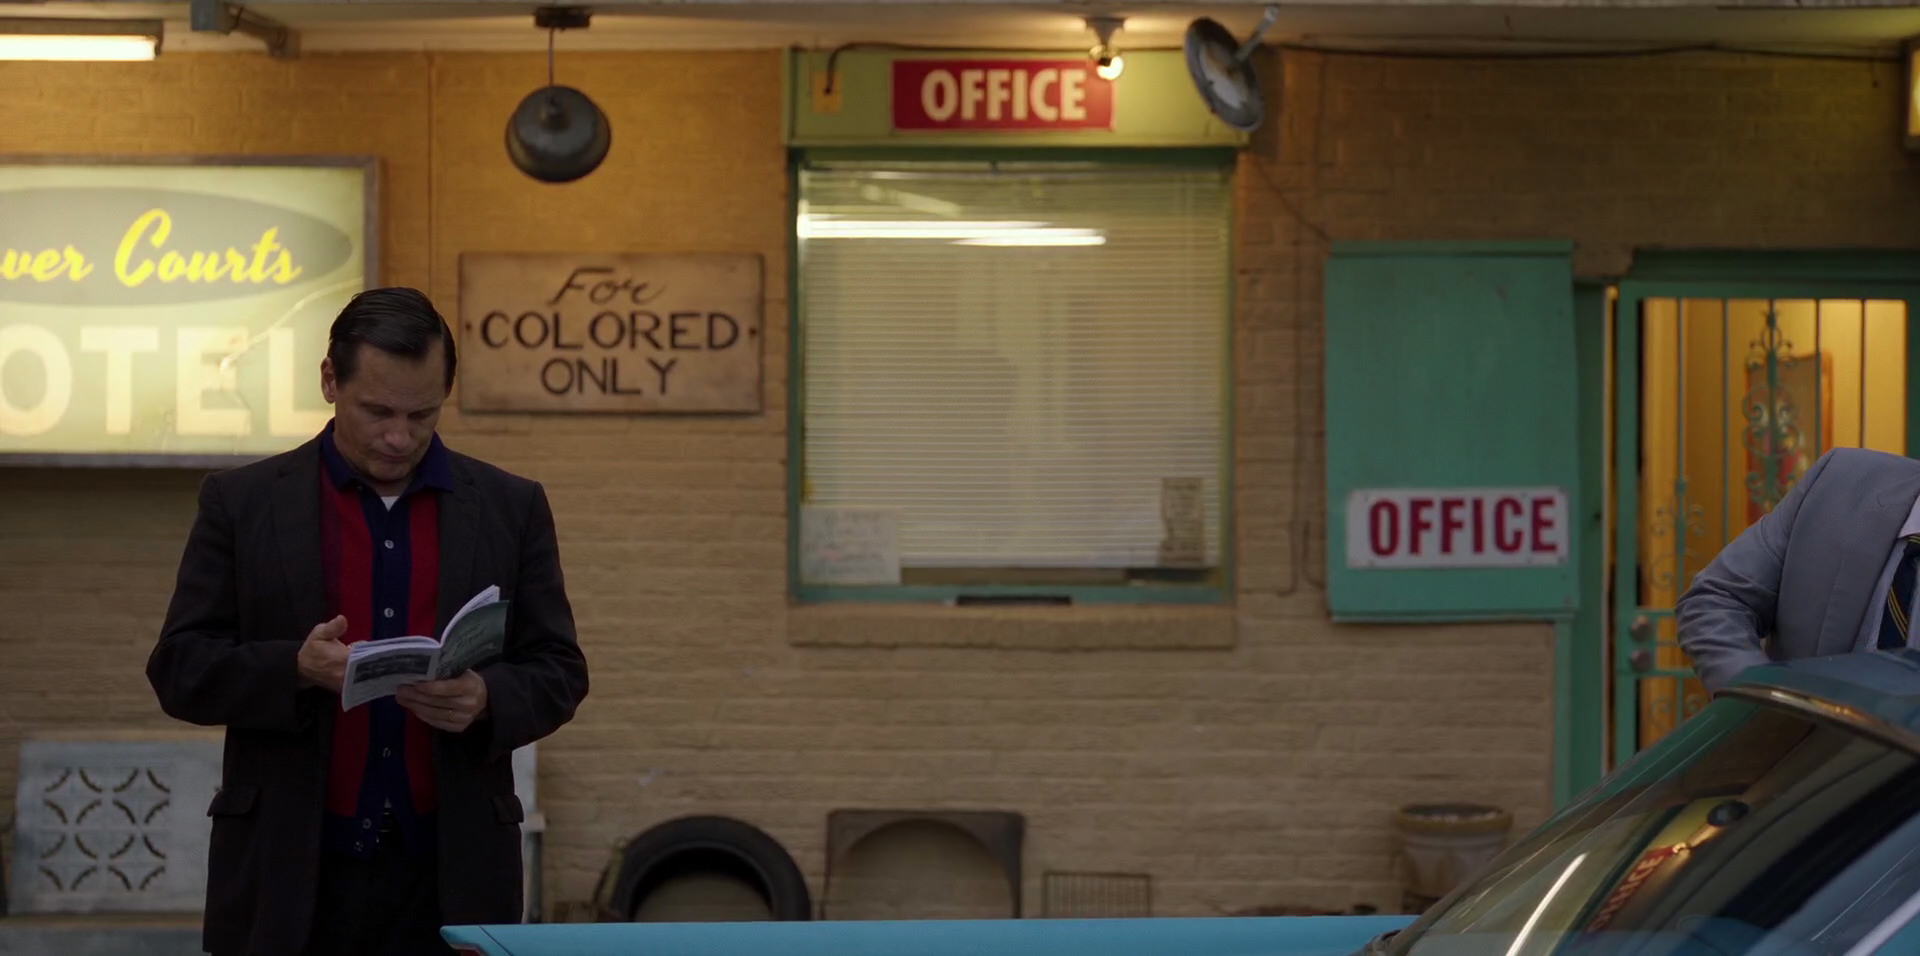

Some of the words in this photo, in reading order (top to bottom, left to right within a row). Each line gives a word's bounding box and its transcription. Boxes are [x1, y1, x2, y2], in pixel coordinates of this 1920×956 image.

[921, 68, 1087, 121] OFFICE
[0, 245, 94, 282] ver
[115, 208, 303, 287] Courts
[549, 267, 666, 305] For
[480, 310, 740, 350] COLORED
[0, 324, 332, 437] OTEL
[540, 357, 678, 396] ONLY
[1368, 497, 1558, 558] OFFICE
